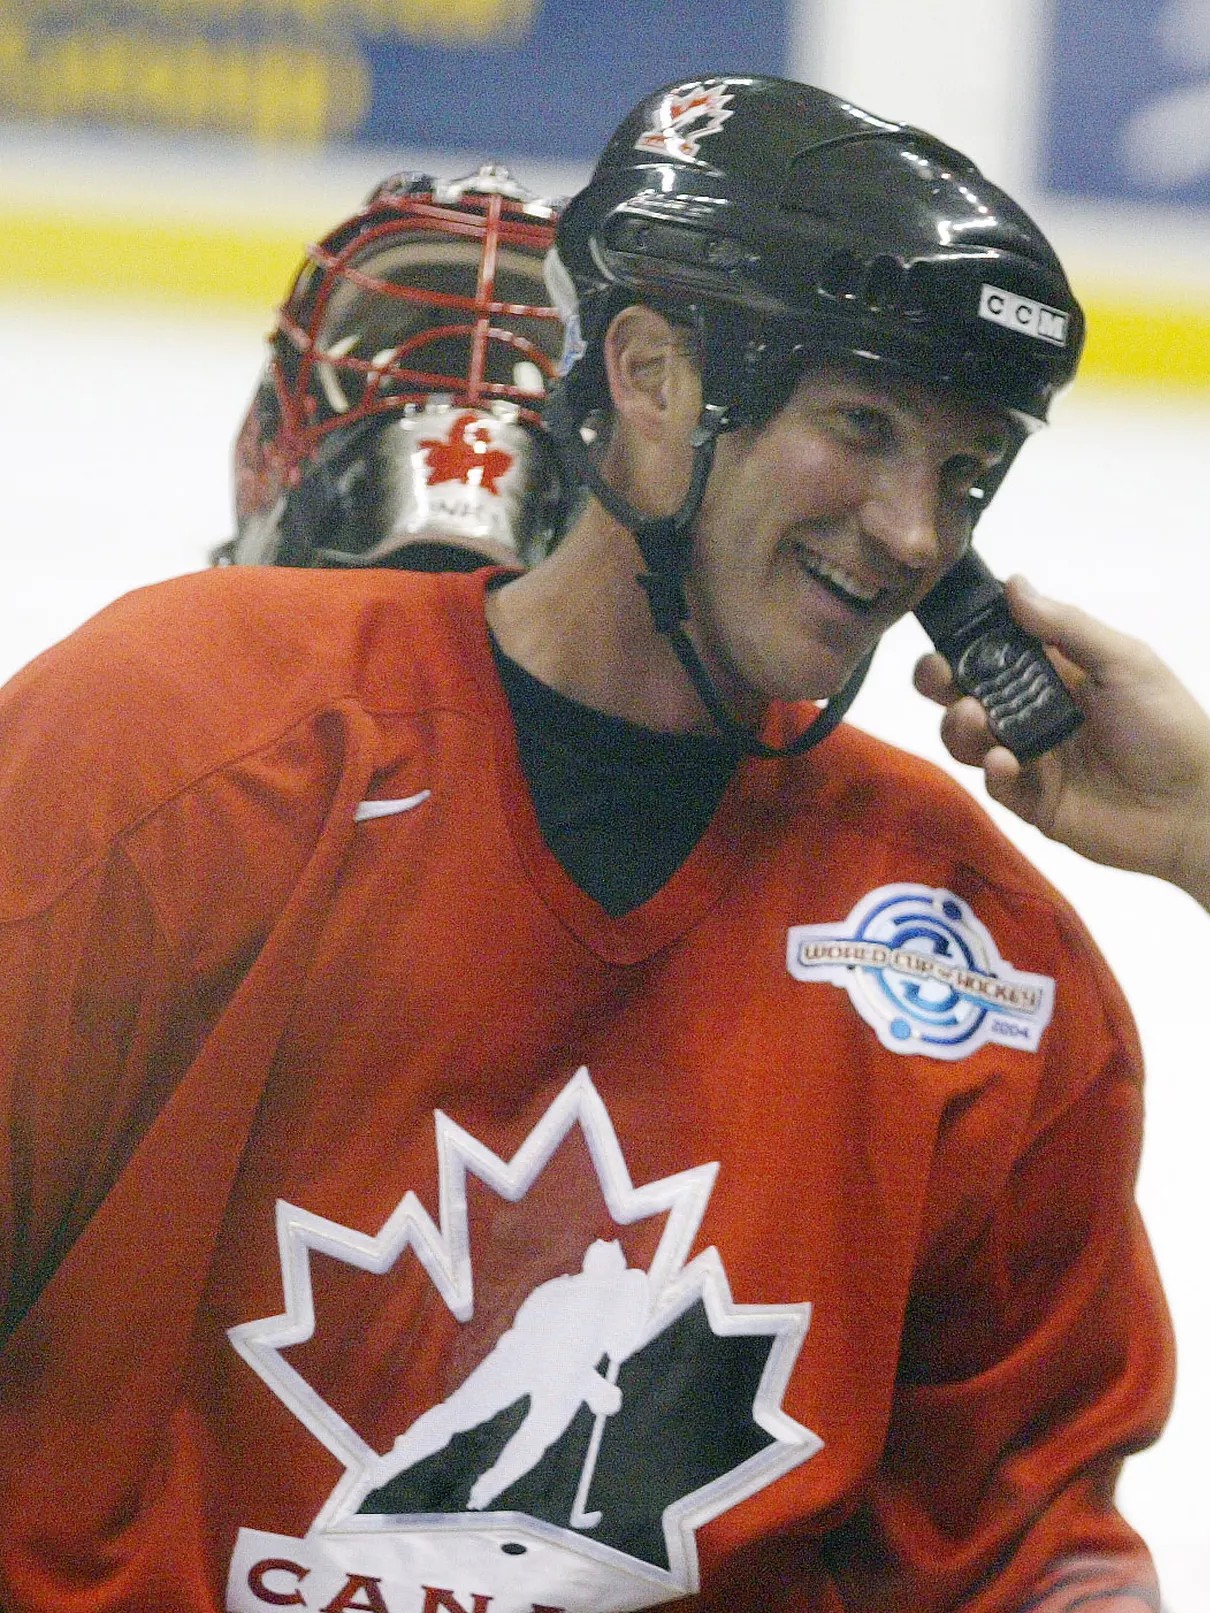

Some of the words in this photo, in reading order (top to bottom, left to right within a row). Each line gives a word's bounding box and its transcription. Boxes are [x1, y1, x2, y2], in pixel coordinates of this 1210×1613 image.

[987, 295, 1066, 343] CCM
[804, 945, 887, 963] WORLD
[894, 949, 934, 973] CUP
[955, 970, 1037, 1006] HOCKEY
[247, 1558, 566, 1612] CAN
